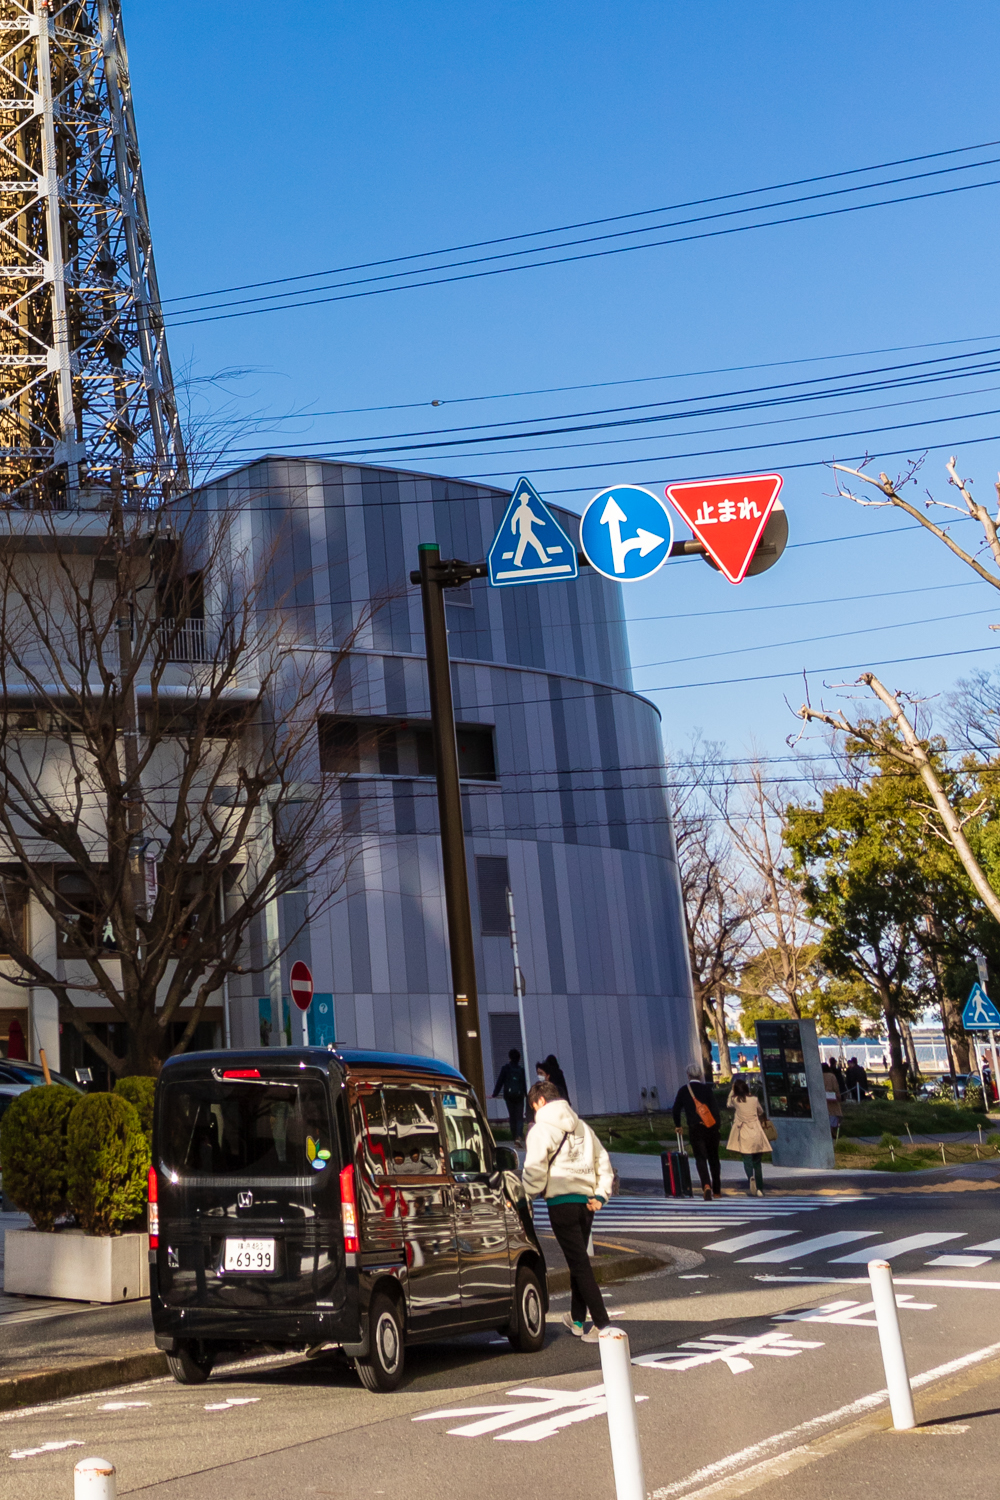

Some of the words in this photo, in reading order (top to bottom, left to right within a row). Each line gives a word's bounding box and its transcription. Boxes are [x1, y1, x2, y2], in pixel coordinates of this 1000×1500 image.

[694, 497, 762, 525] 止まれ
[236, 1252, 271, 1267] 69-99
